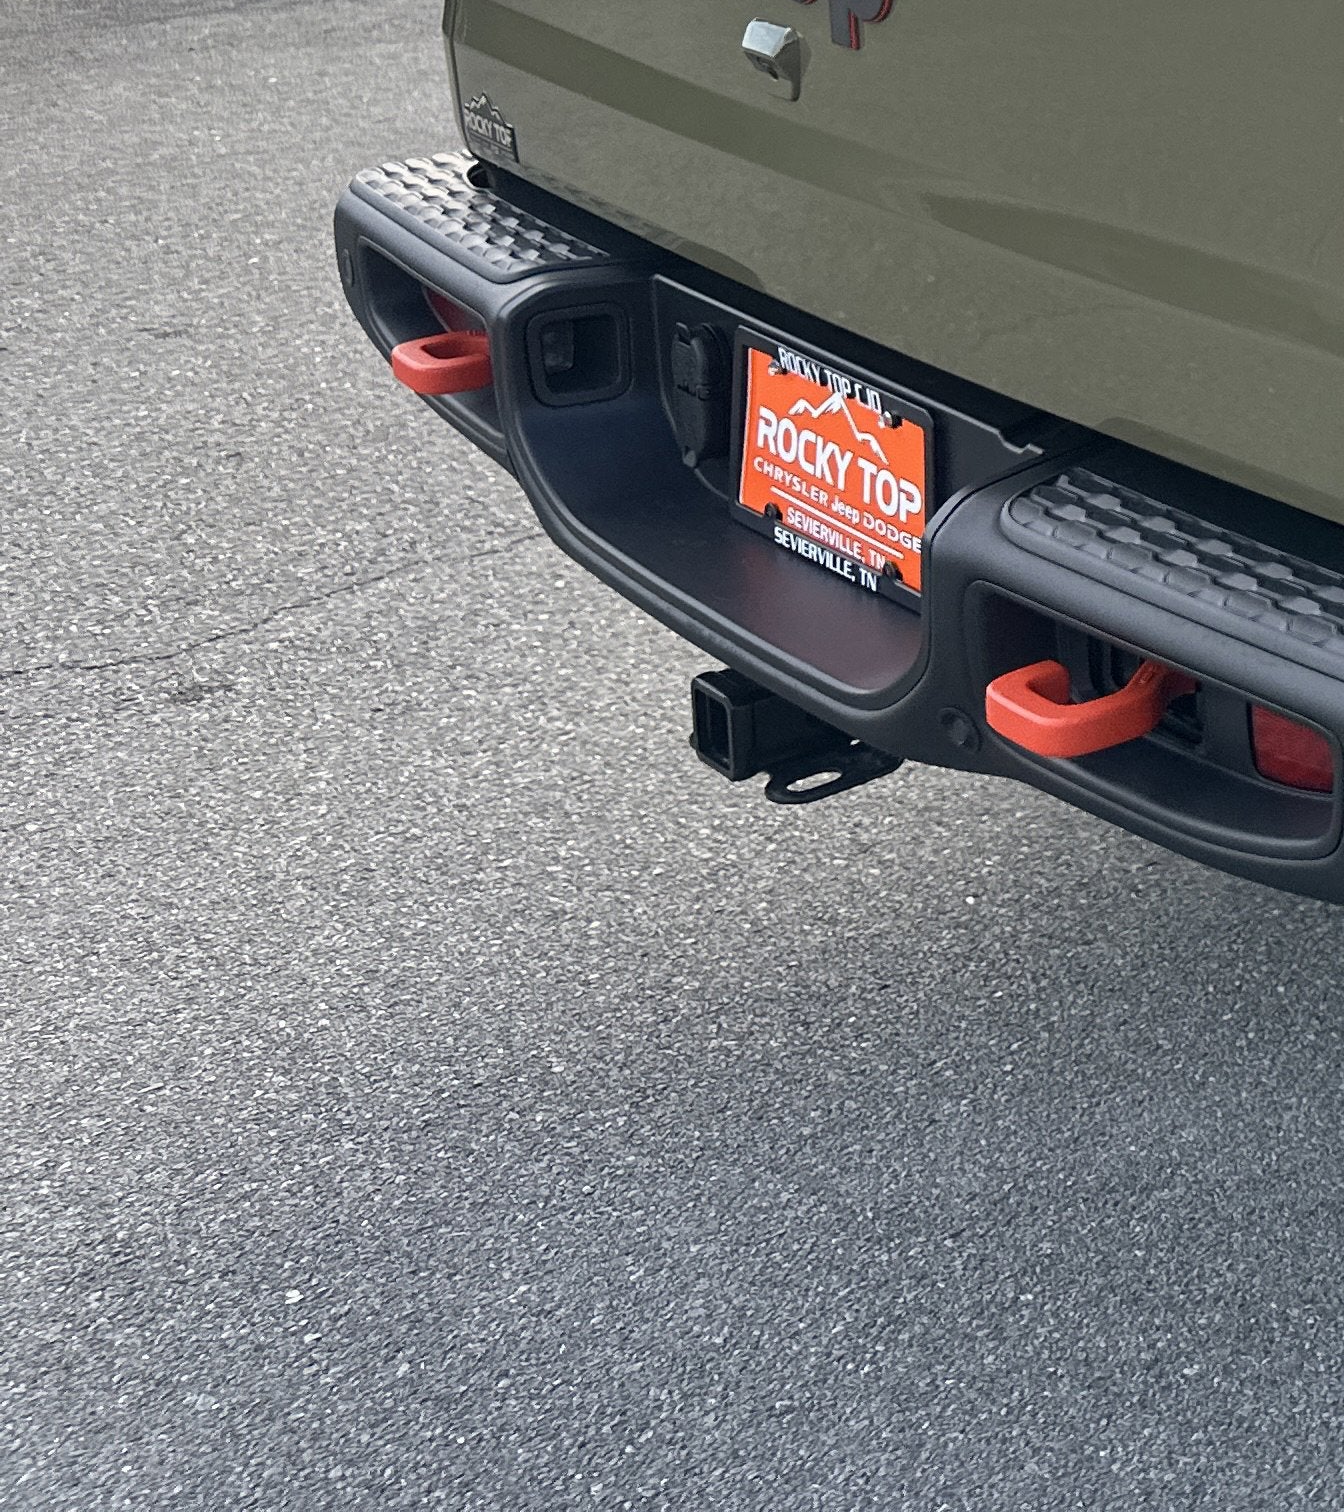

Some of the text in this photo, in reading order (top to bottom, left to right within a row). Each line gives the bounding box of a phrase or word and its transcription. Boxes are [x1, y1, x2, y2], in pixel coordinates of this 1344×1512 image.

[777, 346, 824, 385] ROCKY
[823, 369, 852, 399] TOP
[756, 406, 922, 524] ROCKY TOP
[753, 456, 922, 554] CHRYSLER Jeep DODGE
[859, 569, 878, 593] TN
[868, 548, 886, 571] TN
